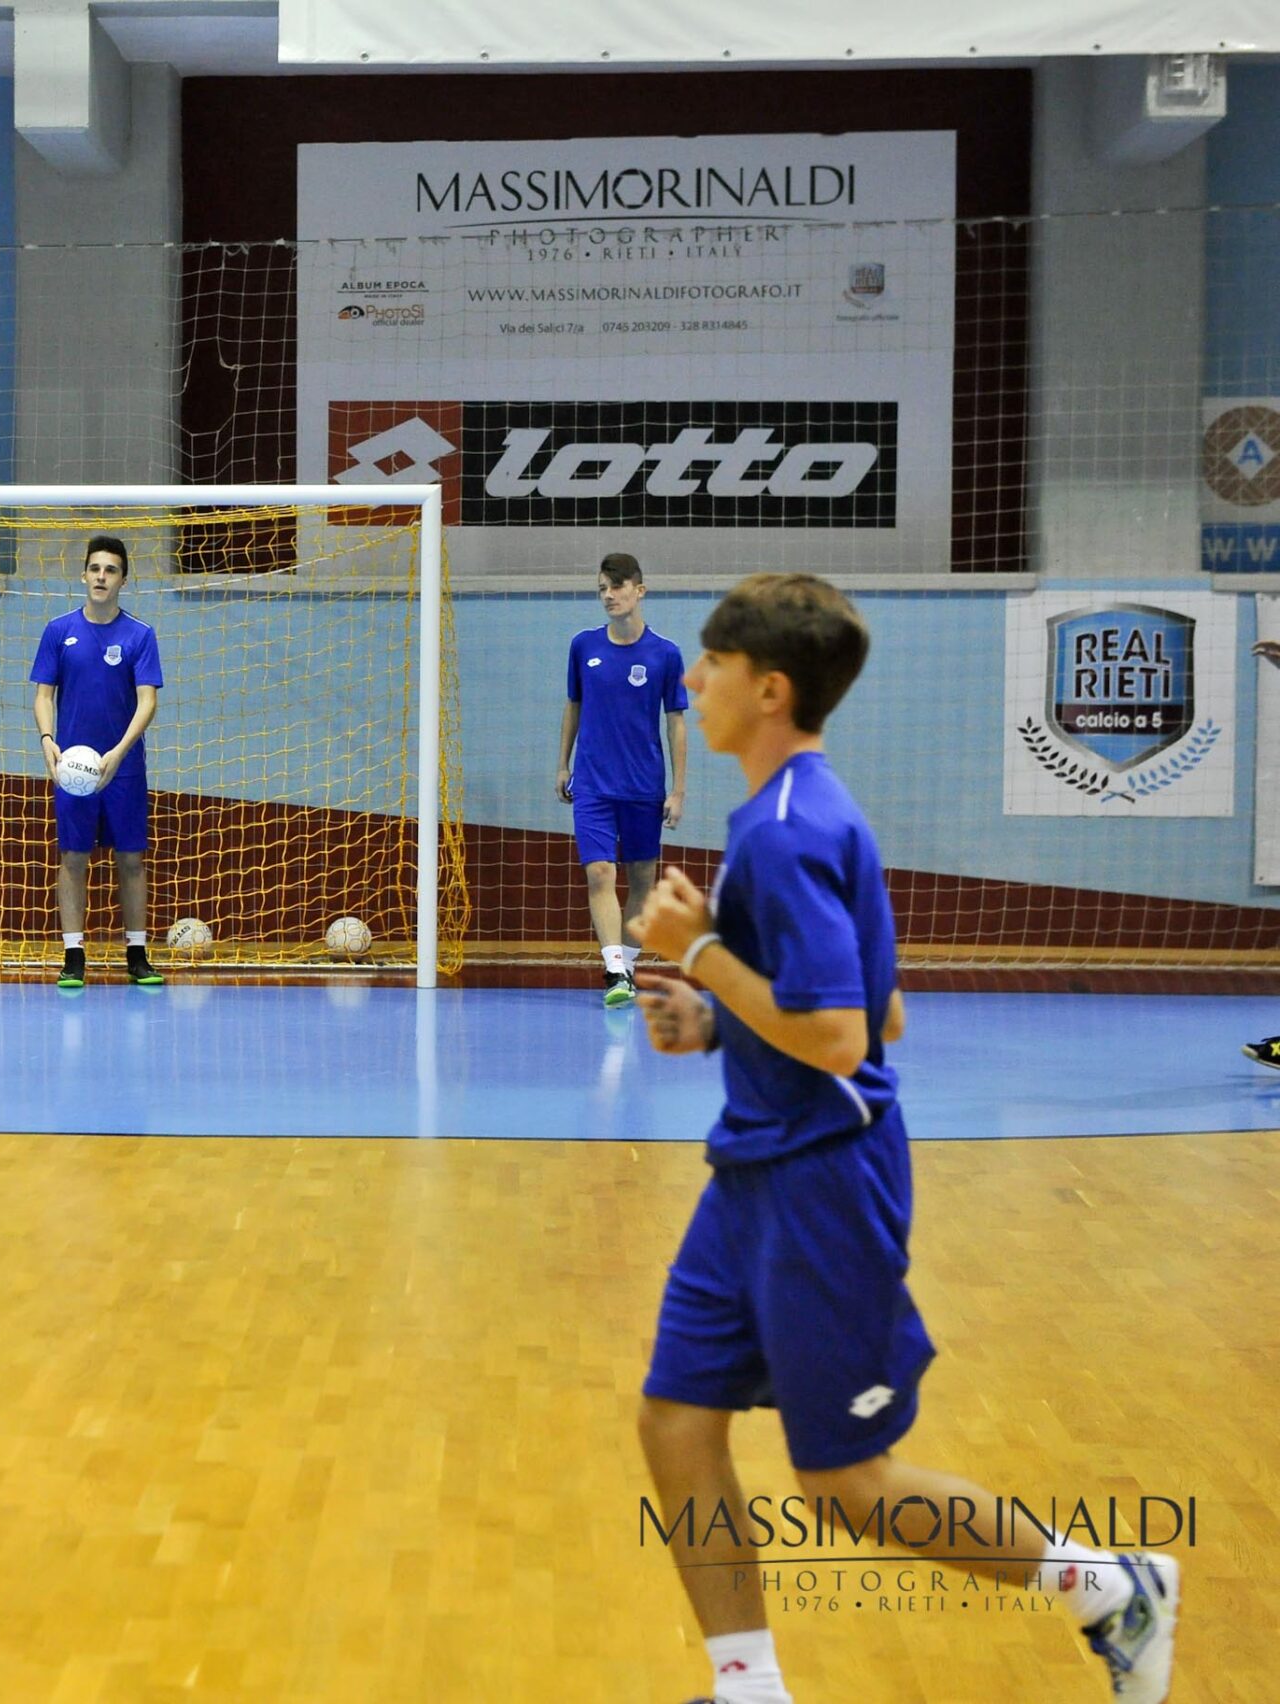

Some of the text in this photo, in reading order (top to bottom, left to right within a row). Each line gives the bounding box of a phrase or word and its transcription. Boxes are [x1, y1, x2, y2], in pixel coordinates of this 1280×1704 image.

[416, 163, 856, 213] MASSIMORINALDI
[489, 225, 781, 246] PHOTOGRAPHER
[526, 245, 744, 263] 1976 RIETI ITALY
[341, 281, 426, 290] ALBUM EPOCA
[467, 284, 803, 302] WWW.MASSIMORINALDIFOTOGRAFO.IT
[499, 323, 516, 334] Via
[518, 323, 535, 334] dei
[484, 428, 880, 498] lotto
[1074, 628, 1171, 666] REAL
[1074, 666, 1171, 699] RIETI
[1075, 712, 1162, 728] calcio a 5
